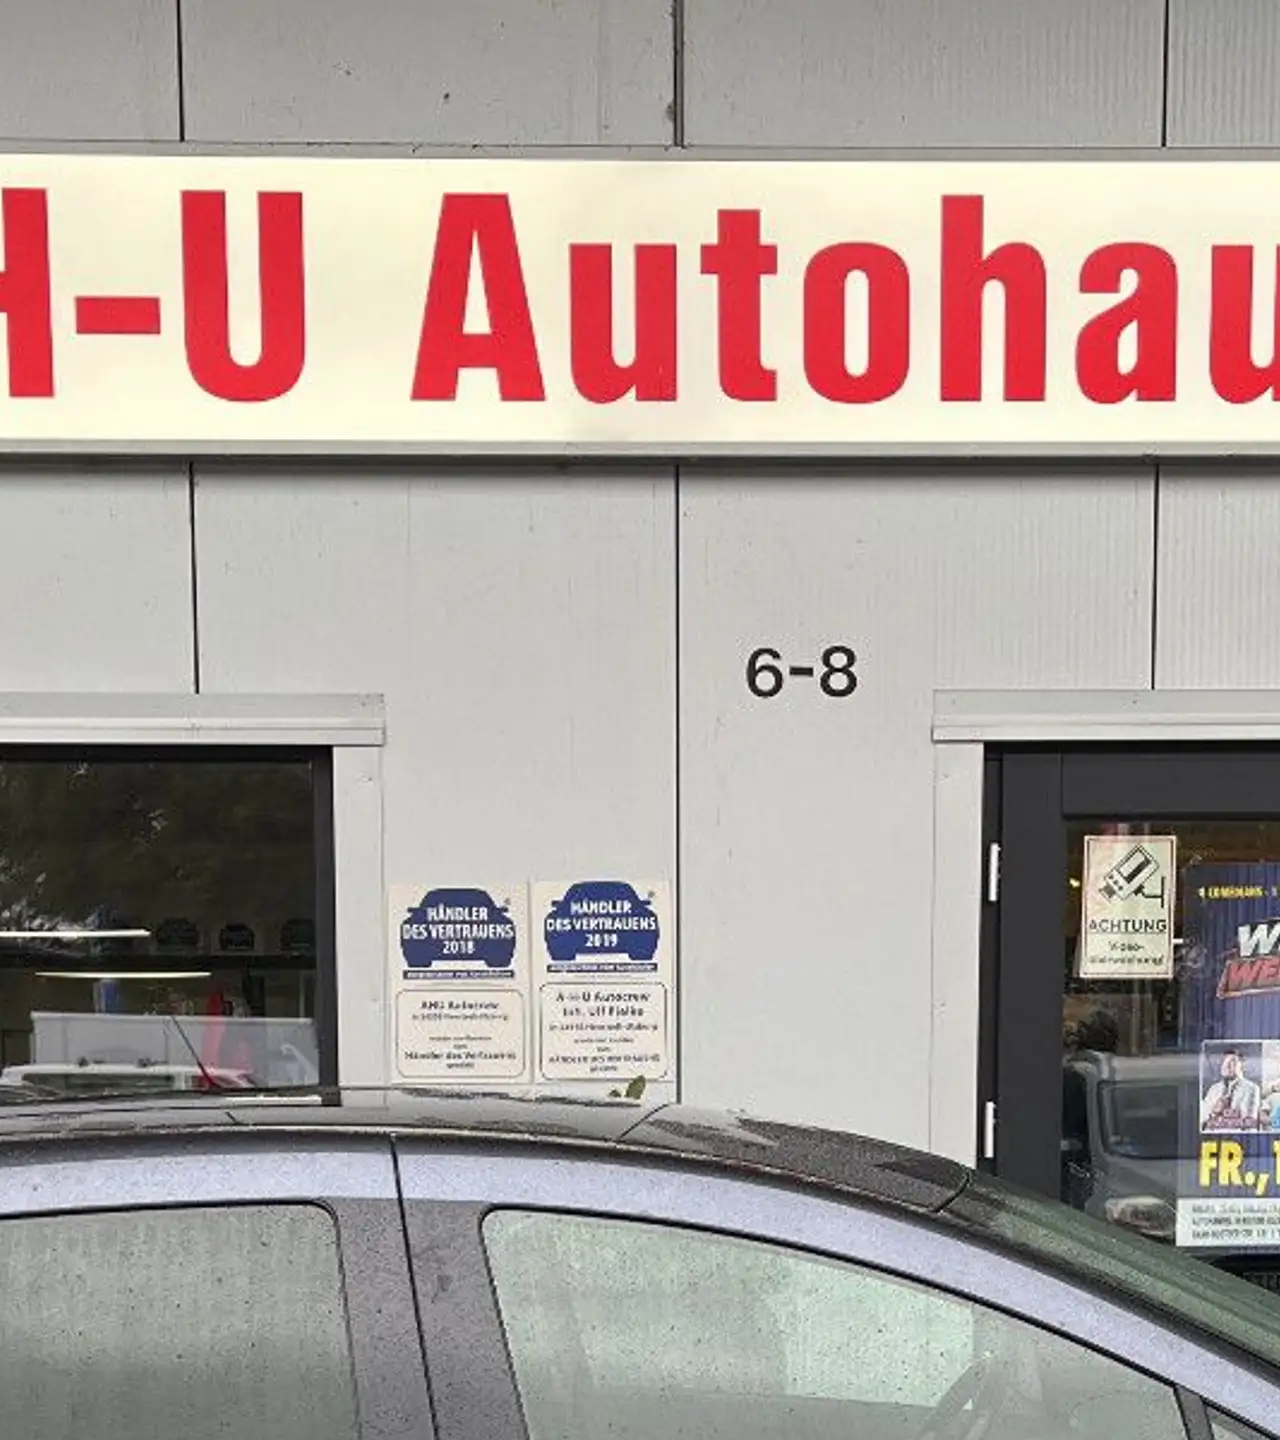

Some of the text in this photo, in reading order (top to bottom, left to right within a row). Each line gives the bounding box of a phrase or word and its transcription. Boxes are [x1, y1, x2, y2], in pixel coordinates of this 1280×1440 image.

[746, 646, 858, 698] 6-8
[427, 903, 489, 922] HÄNDLER
[570, 899, 632, 917] HÄNDLER
[402, 924, 515, 940] DES VERTRAUENS
[546, 917, 657, 934] DES VERTRAUENS
[1089, 919, 1167, 933] ACHTUNG
